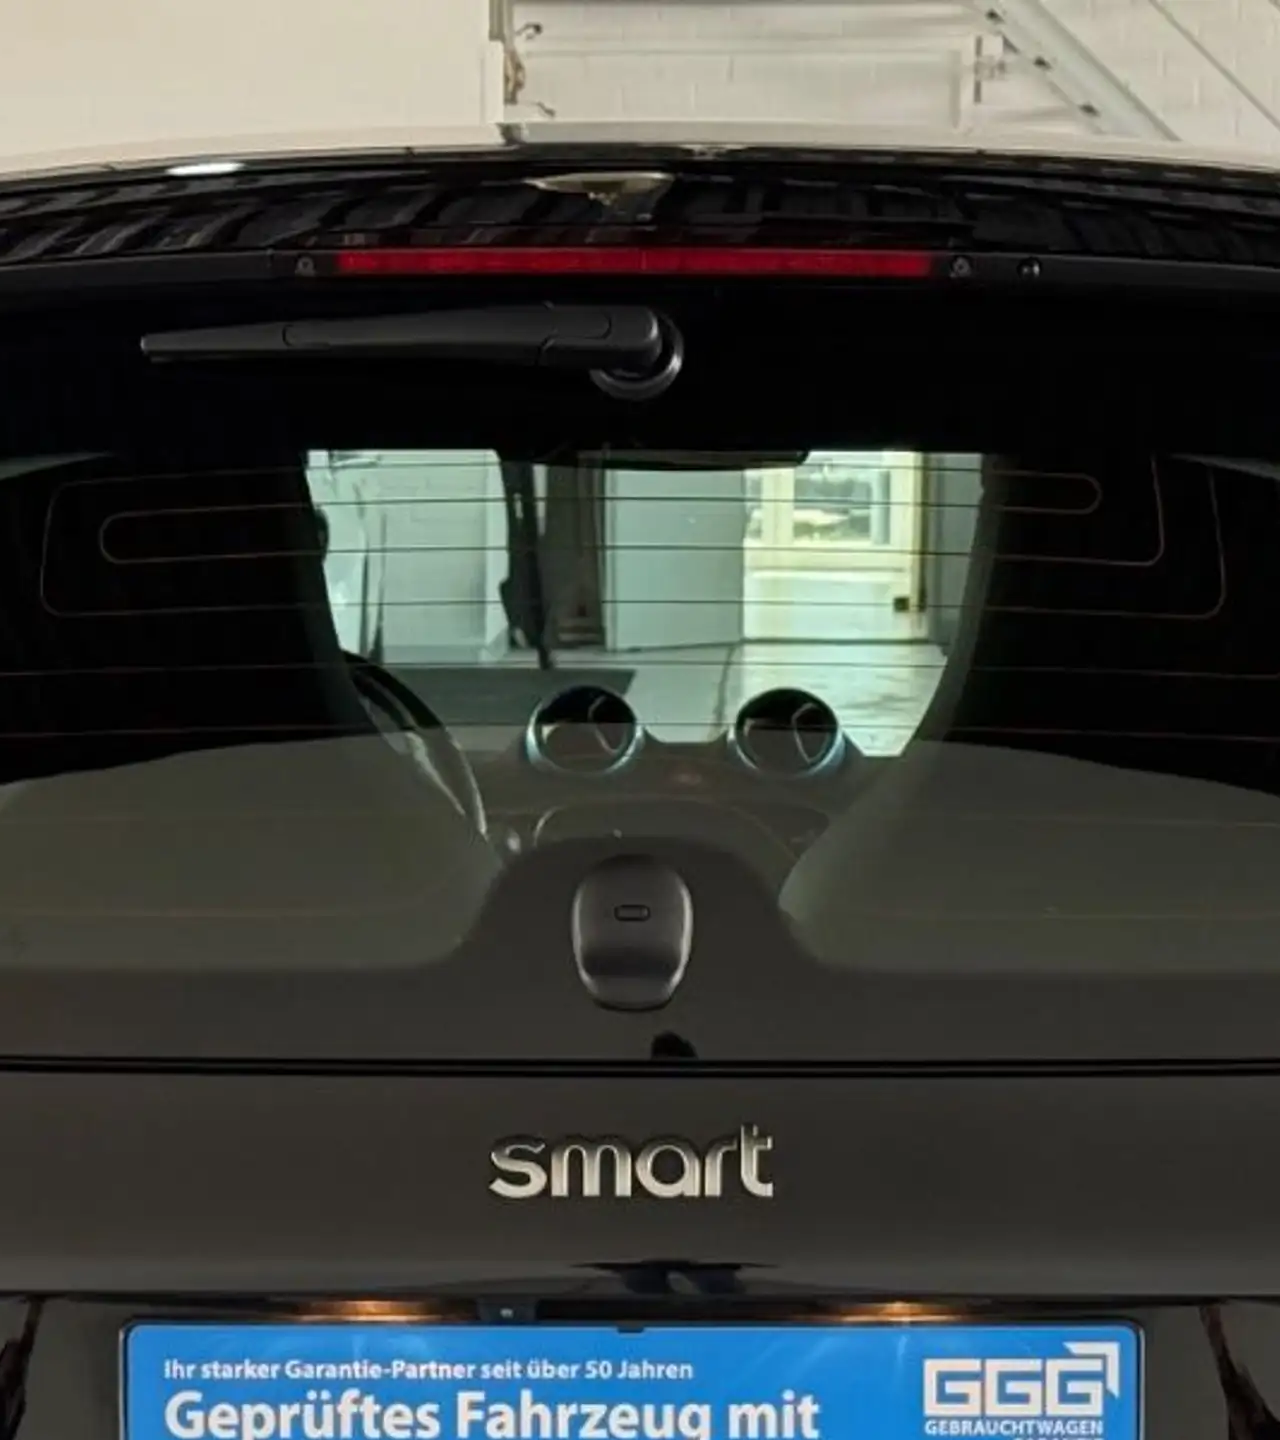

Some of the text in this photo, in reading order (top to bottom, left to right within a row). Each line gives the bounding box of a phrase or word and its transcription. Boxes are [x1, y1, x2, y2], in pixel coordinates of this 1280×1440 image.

[488, 1122, 774, 1199] smart
[164, 1359, 694, 1380] Ihr starker Garantie-Partner seit über 50 Jahren
[923, 1357, 1104, 1417] GGG
[728, 1388, 821, 1440] mit
[924, 1420, 1104, 1436] GEBRAUCHTWAGEN
